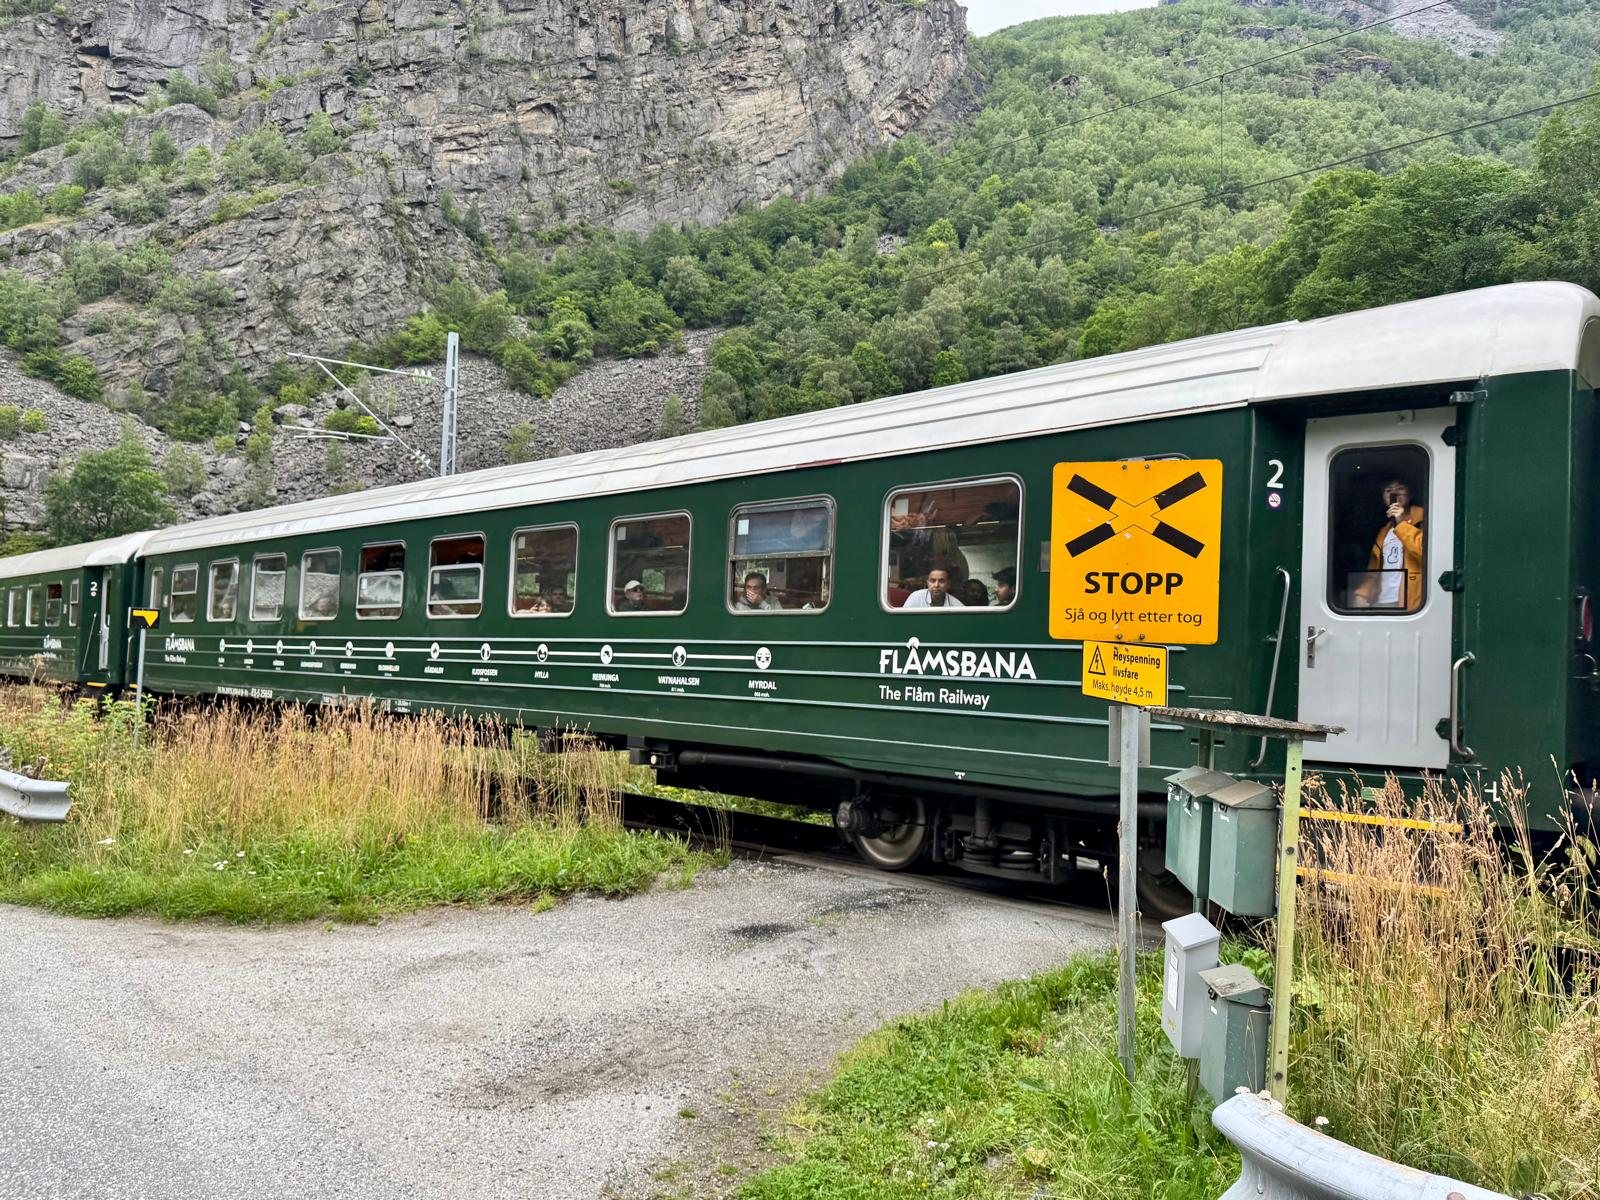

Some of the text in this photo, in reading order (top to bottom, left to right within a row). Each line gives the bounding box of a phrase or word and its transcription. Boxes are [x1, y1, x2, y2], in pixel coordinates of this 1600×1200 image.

[1267, 459, 1284, 489] 2
[90, 581, 98, 591] 2
[1084, 572, 1184, 595] STOPP
[1065, 607, 1202, 626] Sjå og lytt etter tog
[879, 637, 1037, 680] FLÅMSBANA
[1113, 650, 1161, 668] Høyspenning
[592, 673, 619, 682] REINUNGA
[658, 676, 700, 686] VATNAHALSEN
[1112, 666, 1139, 680] livsfare
[748, 680, 777, 690] MYRDAL
[1092, 679, 1153, 698] Maks. høyde 4,5 m
[879, 685, 990, 710] The Flåm Railway
